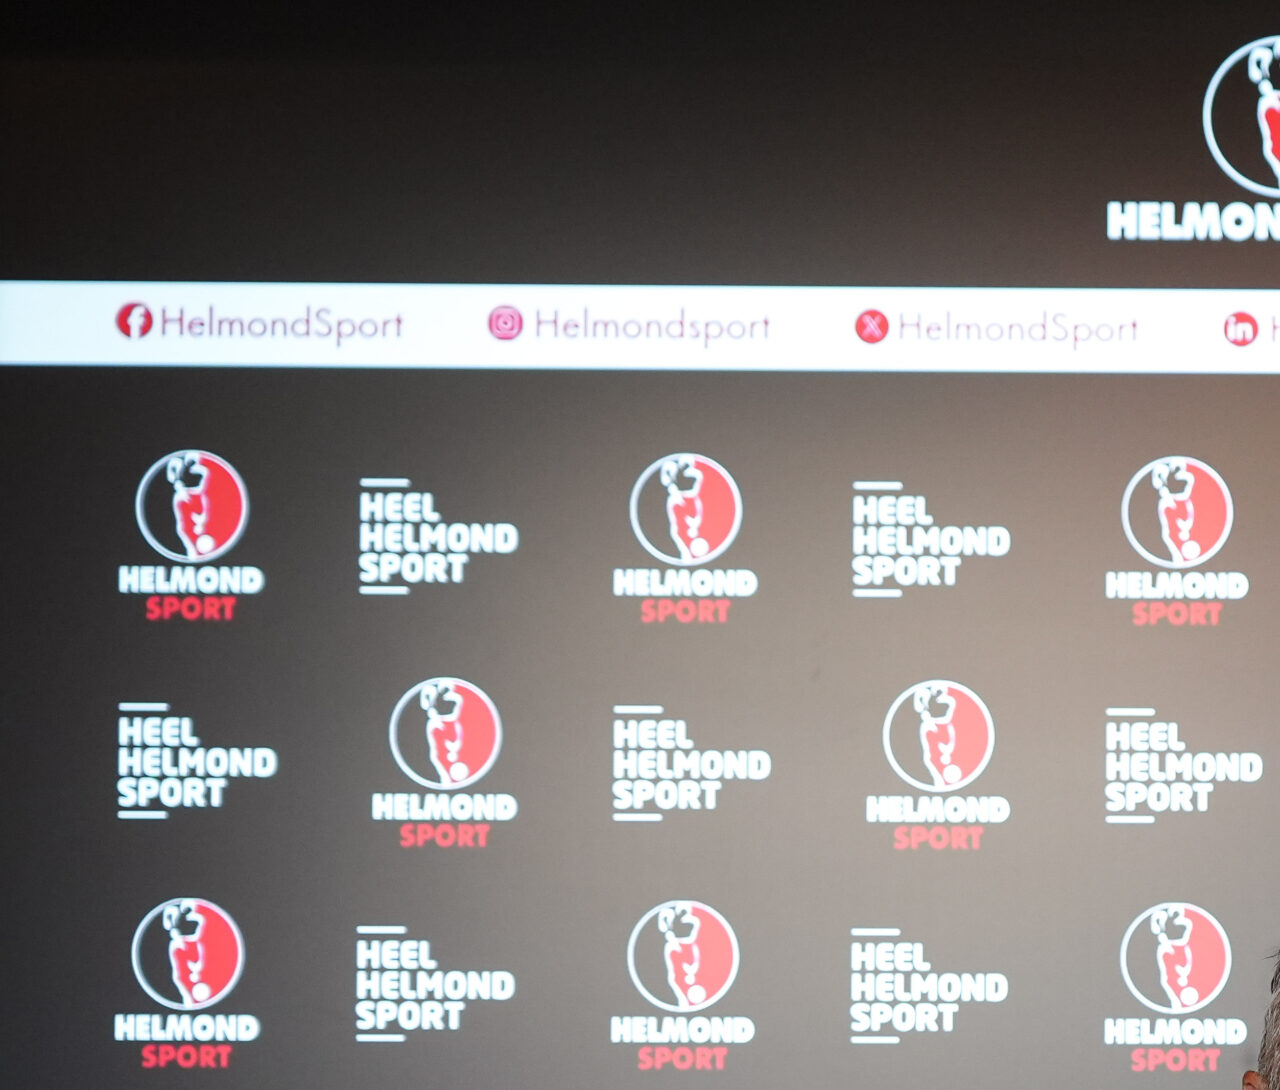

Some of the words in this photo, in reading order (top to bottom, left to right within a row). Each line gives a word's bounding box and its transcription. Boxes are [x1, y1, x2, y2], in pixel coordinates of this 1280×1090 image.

[160, 304, 404, 349] HelmondSport
[536, 306, 770, 350] Helmondsport
[900, 311, 1138, 351] HelmondSport
[360, 492, 441, 523] HEEL
[851, 495, 933, 526] HEEL
[358, 522, 519, 553] HELMOND
[851, 525, 1011, 556] HELMOND
[118, 565, 264, 594] HELMOND
[359, 552, 470, 583] SPORT
[612, 568, 759, 597] HELMOND
[850, 555, 961, 586] SPORT
[1104, 570, 1250, 600] HELMOND
[145, 595, 238, 621] SPORT
[641, 598, 732, 623] SPORT
[1132, 601, 1223, 626] SPORT
[118, 716, 199, 747] HEEL
[612, 719, 695, 750] HEEL
[1103, 721, 1185, 752] HEEL
[118, 747, 277, 778] HELMOND
[611, 749, 772, 780] HELMOND
[1103, 751, 1264, 782] HELMOND
[117, 776, 227, 808] SPORT
[371, 792, 518, 821] HELMOND
[611, 779, 722, 810] SPORT
[1102, 781, 1213, 812] SPORT
[865, 794, 1012, 824] HELMOND
[399, 823, 491, 849] SPORT
[894, 825, 984, 850] SPORT
[356, 939, 438, 970] HEEL
[850, 941, 932, 973] HEEL
[356, 970, 516, 1001] HELMOND
[849, 971, 1009, 1002] HELMOND
[114, 1014, 260, 1042] HELMOND
[355, 1000, 466, 1031] SPORT
[610, 1015, 756, 1044] HELMOND
[849, 1001, 960, 1032] SPORT
[1103, 1017, 1248, 1046] HELMOND
[141, 1043, 234, 1069] SPORT
[638, 1045, 729, 1071] SPORT
[1131, 1047, 1222, 1072] SPORT
